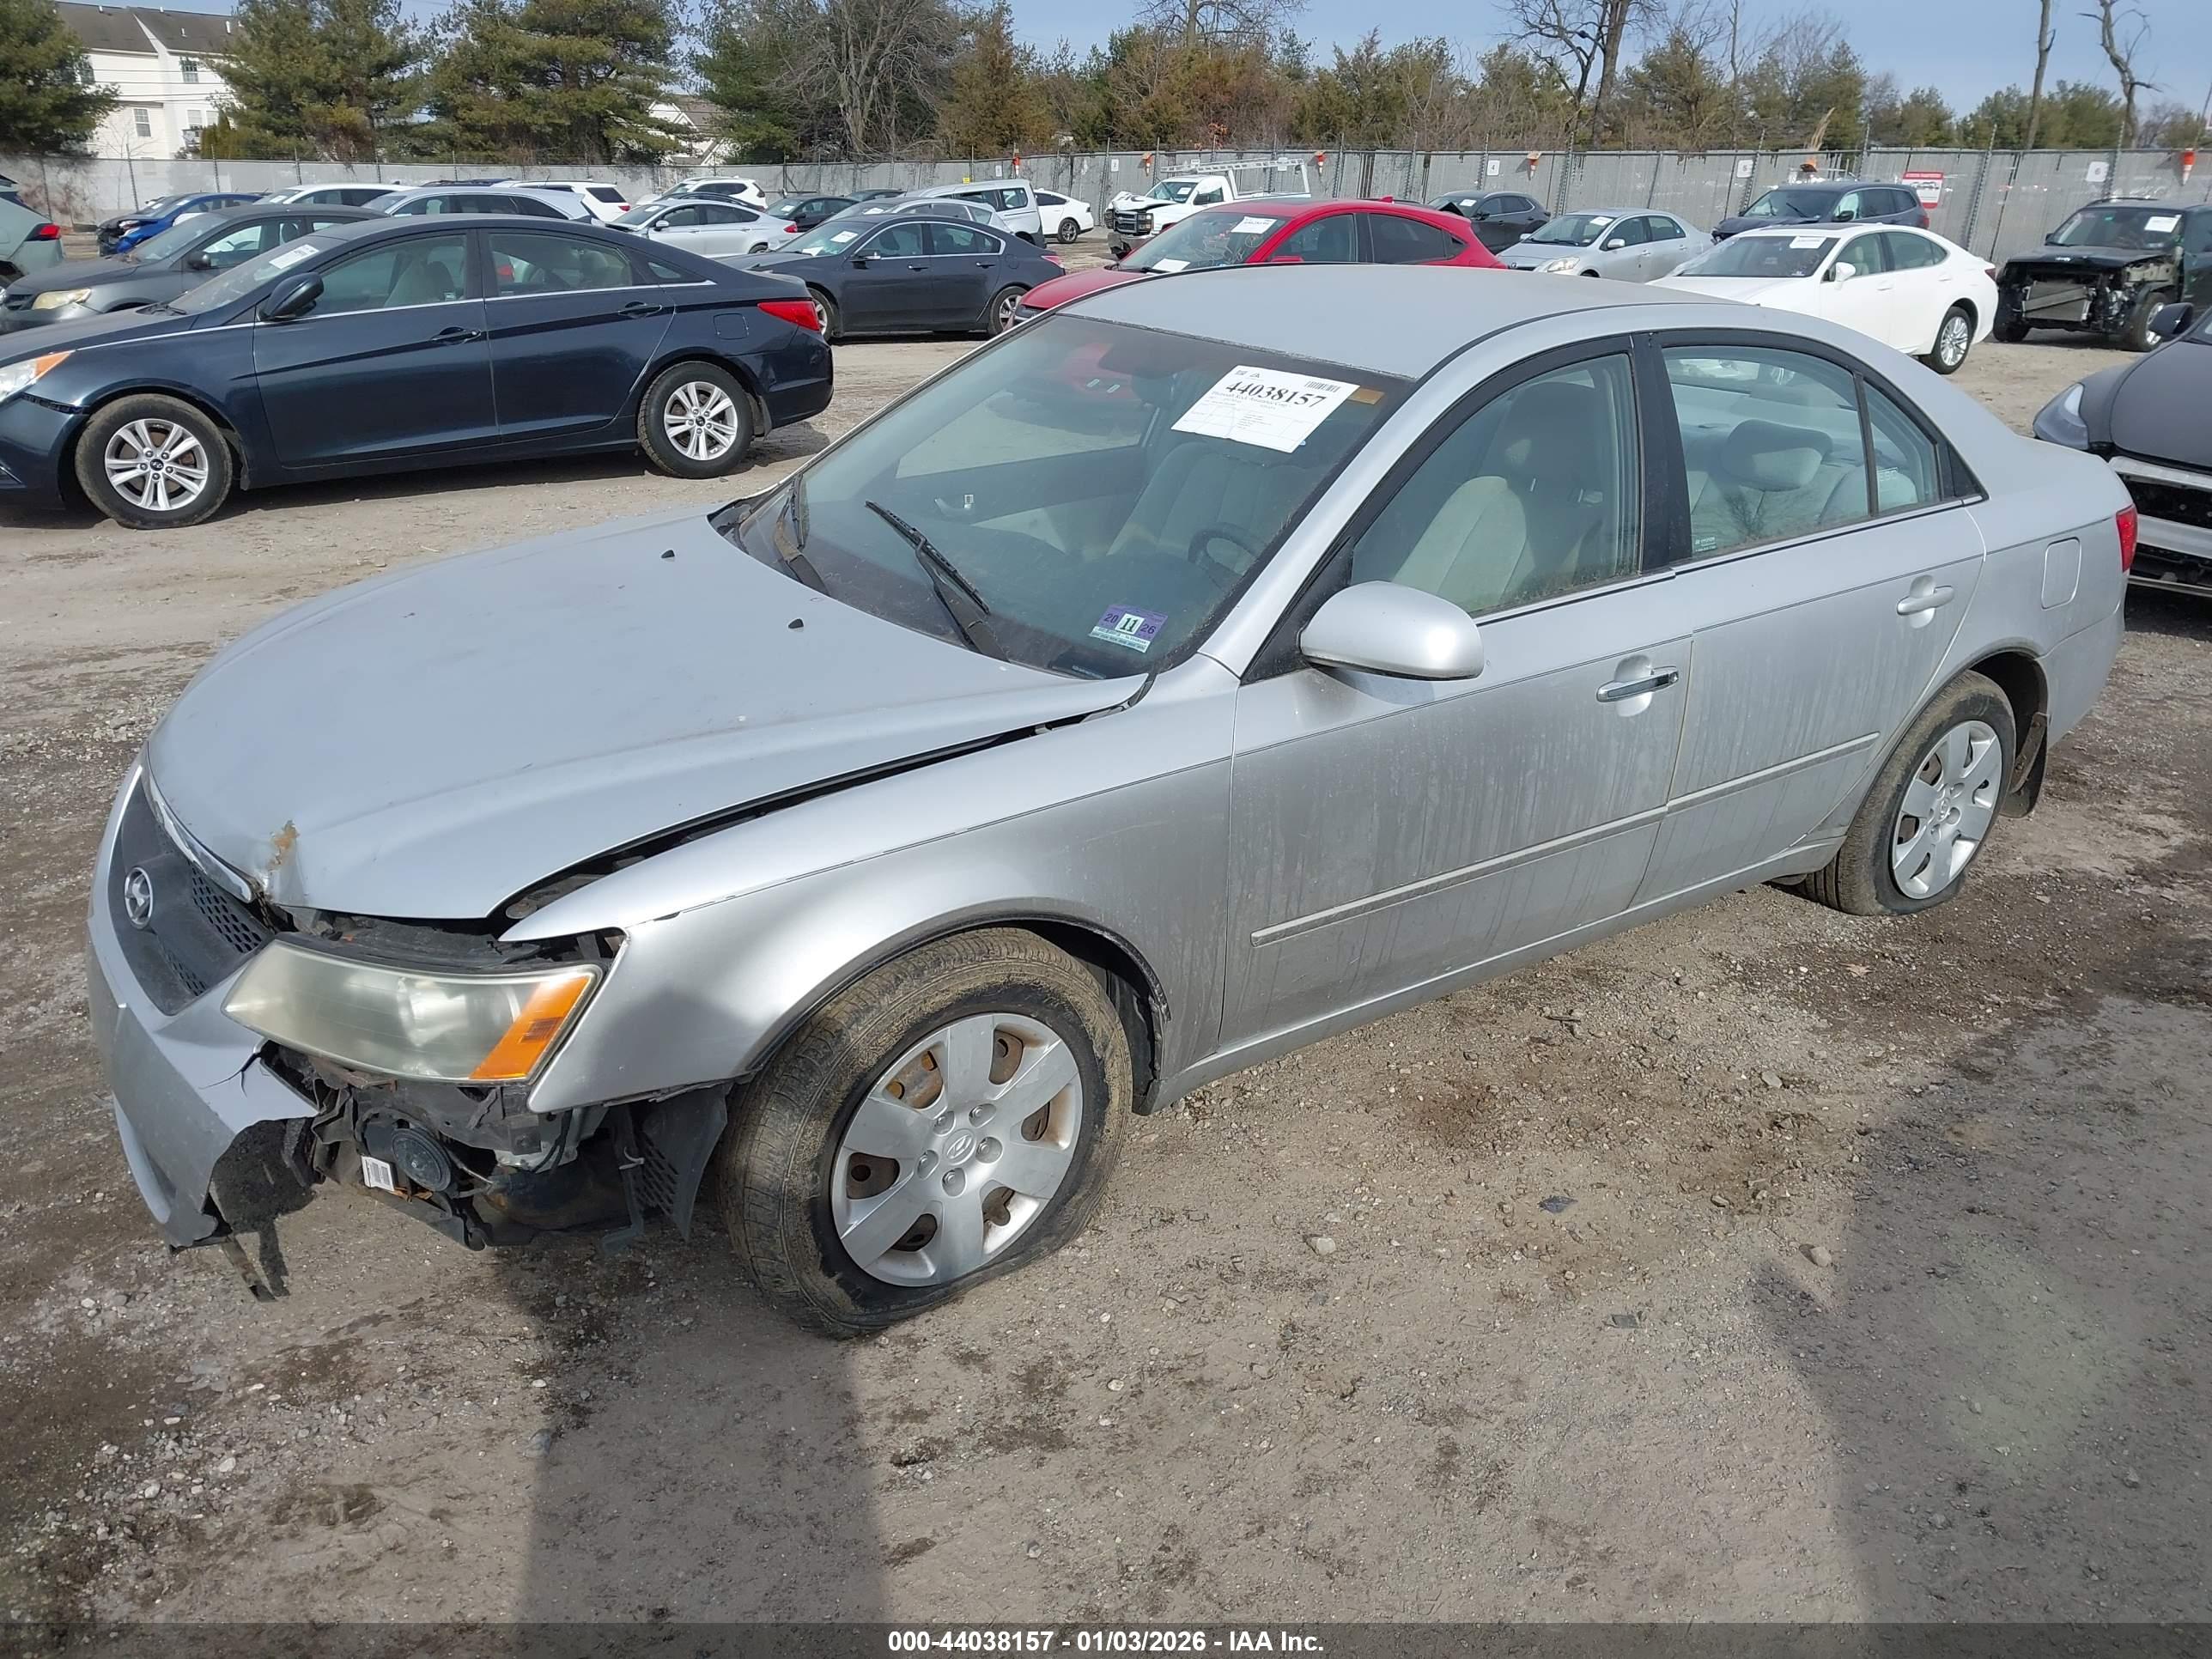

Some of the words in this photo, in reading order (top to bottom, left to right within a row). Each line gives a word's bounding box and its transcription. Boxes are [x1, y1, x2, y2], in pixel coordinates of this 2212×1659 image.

[1226, 380, 1328, 408] 44038157
[1103, 613, 1119, 623] 20
[1120, 617, 1138, 633] 11
[1140, 623, 1156, 635] 26
